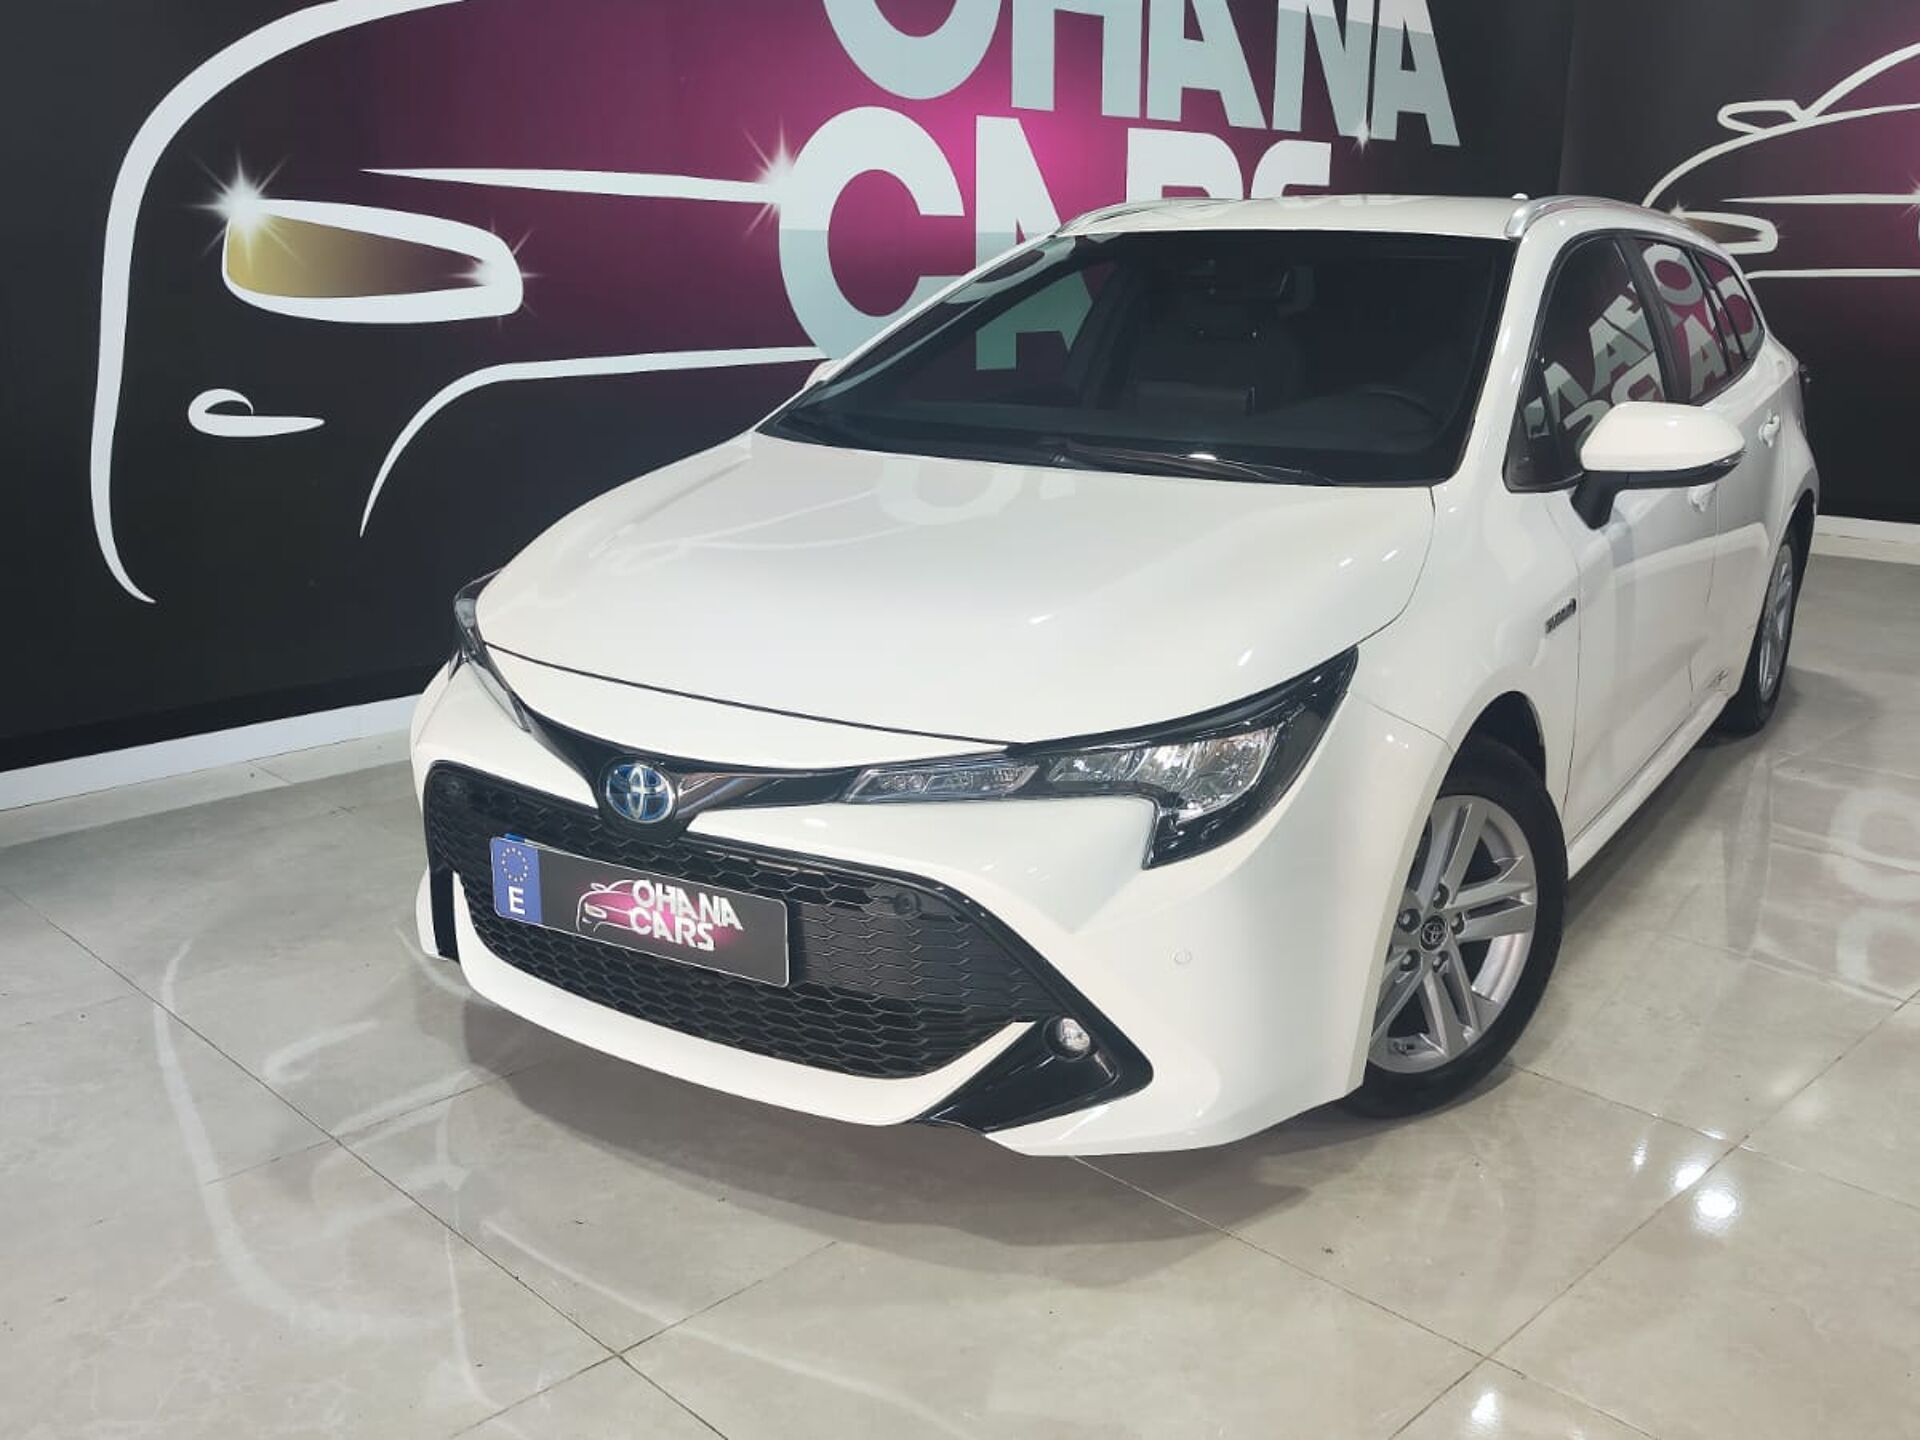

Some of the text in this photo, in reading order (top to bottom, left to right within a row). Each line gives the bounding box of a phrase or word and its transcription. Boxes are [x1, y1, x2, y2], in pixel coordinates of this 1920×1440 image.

[779, 106, 1332, 370] CA
[508, 885, 526, 915] E
[632, 879, 744, 931] OHANA
[630, 907, 715, 952] CARS
